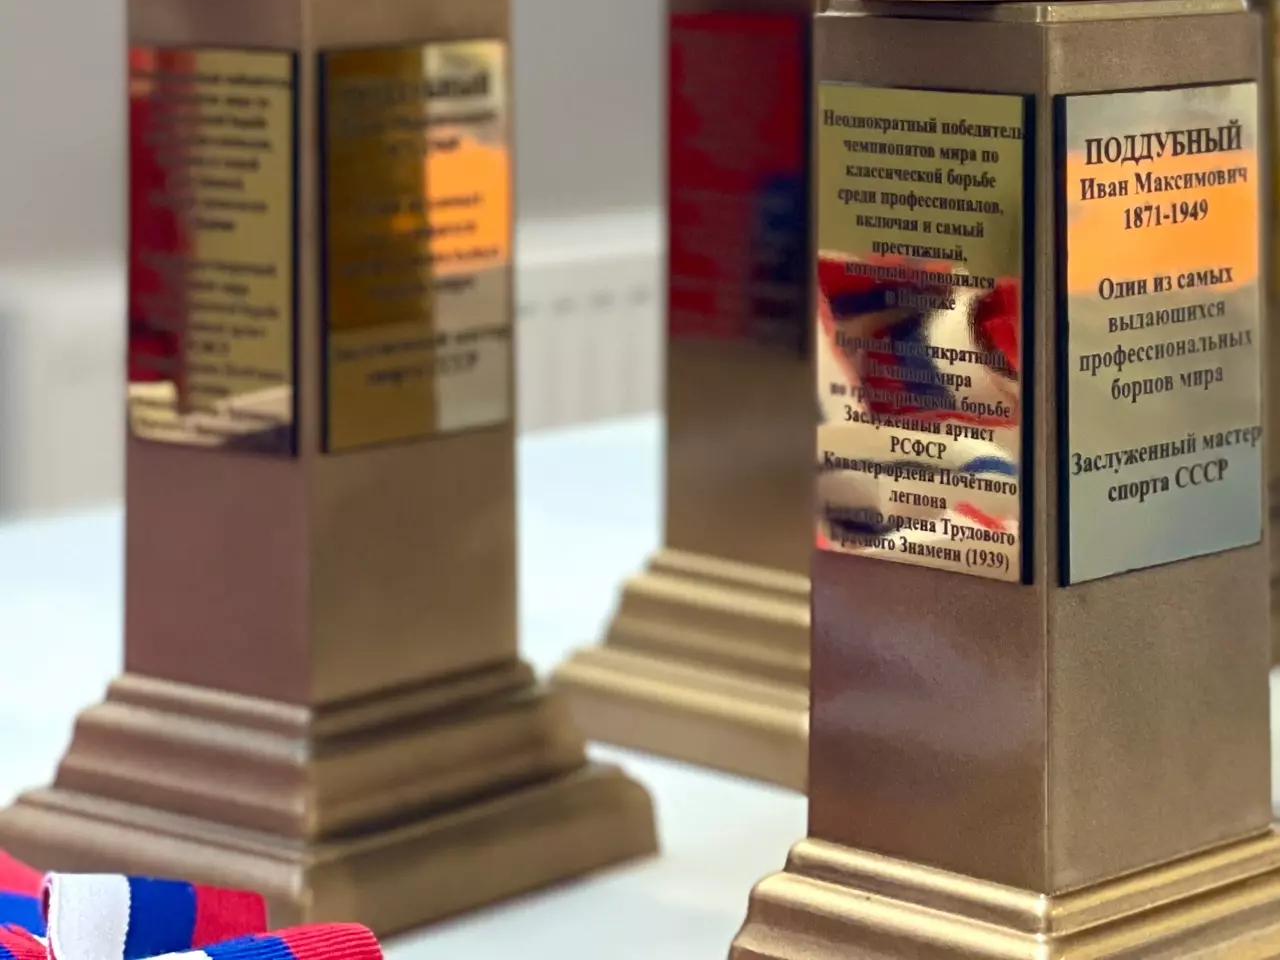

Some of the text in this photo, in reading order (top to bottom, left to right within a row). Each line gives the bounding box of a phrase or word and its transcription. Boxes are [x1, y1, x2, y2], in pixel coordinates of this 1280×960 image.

[824, 110, 936, 134] Неоднократный
[844, 140, 999, 165] чемпионатов мира по
[1085, 119, 1242, 168] ПОДДУБНЫЙ
[846, 164, 996, 190] классической борьбе
[1080, 167, 1248, 201] Иван Максимович
[838, 188, 1004, 216] среди профессионалов,
[1124, 199, 1208, 230] 1871-1949
[856, 214, 984, 238] включая и самый
[872, 240, 968, 262] престижный,
[912, 268, 995, 291] проводился
[1098, 267, 1233, 300] Один из самых
[1108, 300, 1226, 333] выдающихся
[1079, 329, 1252, 376] профессиональных
[935, 372, 972, 391] мира
[1111, 366, 1223, 403] борцов мира
[961, 396, 1011, 417] борьбе
[844, 404, 995, 442] Заслуженный артист
[890, 436, 946, 460] РСФСР
[1072, 425, 1263, 476] Заслуженный мастер
[823, 451, 1017, 495] Кавалер ордена Почётного
[1108, 458, 1229, 503] спорта СССР
[889, 491, 947, 509] легиона
[888, 513, 1016, 546] ордена Трудового
[899, 536, 961, 562] Знамени
[966, 548, 1010, 572] (1939)
